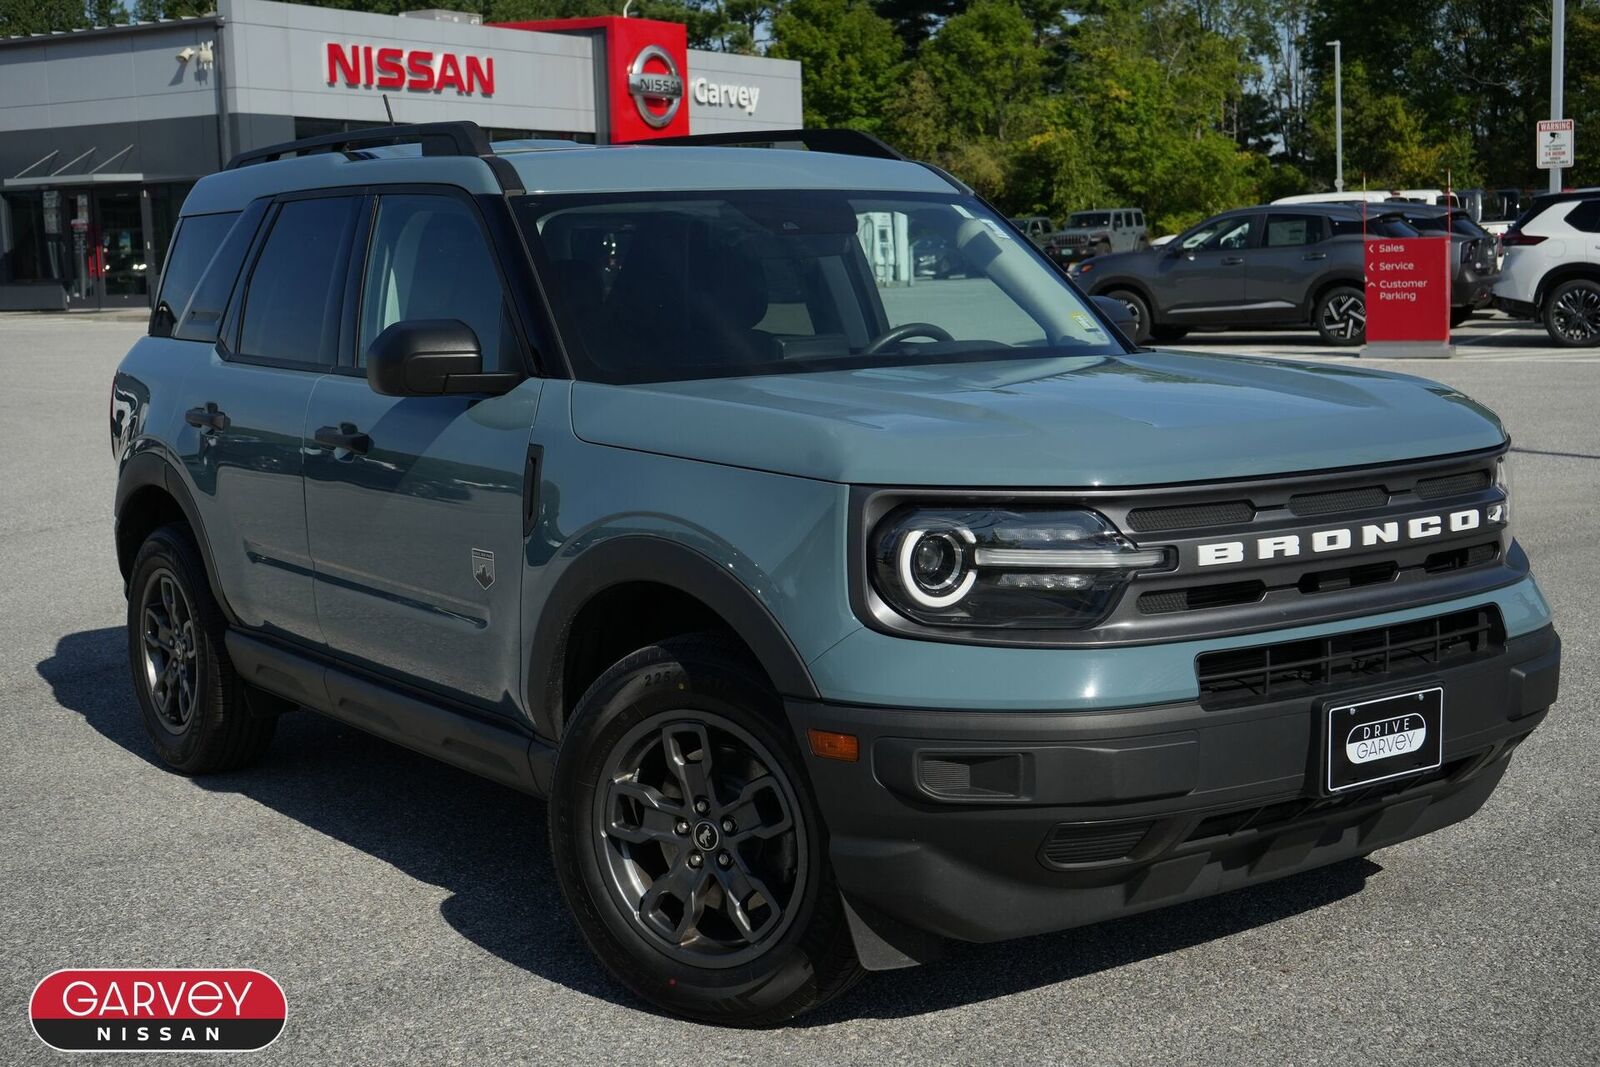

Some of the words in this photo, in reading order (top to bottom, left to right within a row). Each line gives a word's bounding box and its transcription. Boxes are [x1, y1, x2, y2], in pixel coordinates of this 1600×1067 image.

[326, 42, 495, 97] NISSAN
[694, 77, 760, 113] Garvey
[1540, 121, 1571, 131] WARNING
[1379, 243, 1405, 253] Sales
[1379, 262, 1414, 271] Service
[1379, 280, 1428, 289] Customer
[1380, 292, 1417, 302] Parking
[1197, 509, 1480, 566] BRONCO
[1363, 718, 1410, 739] DRIVE
